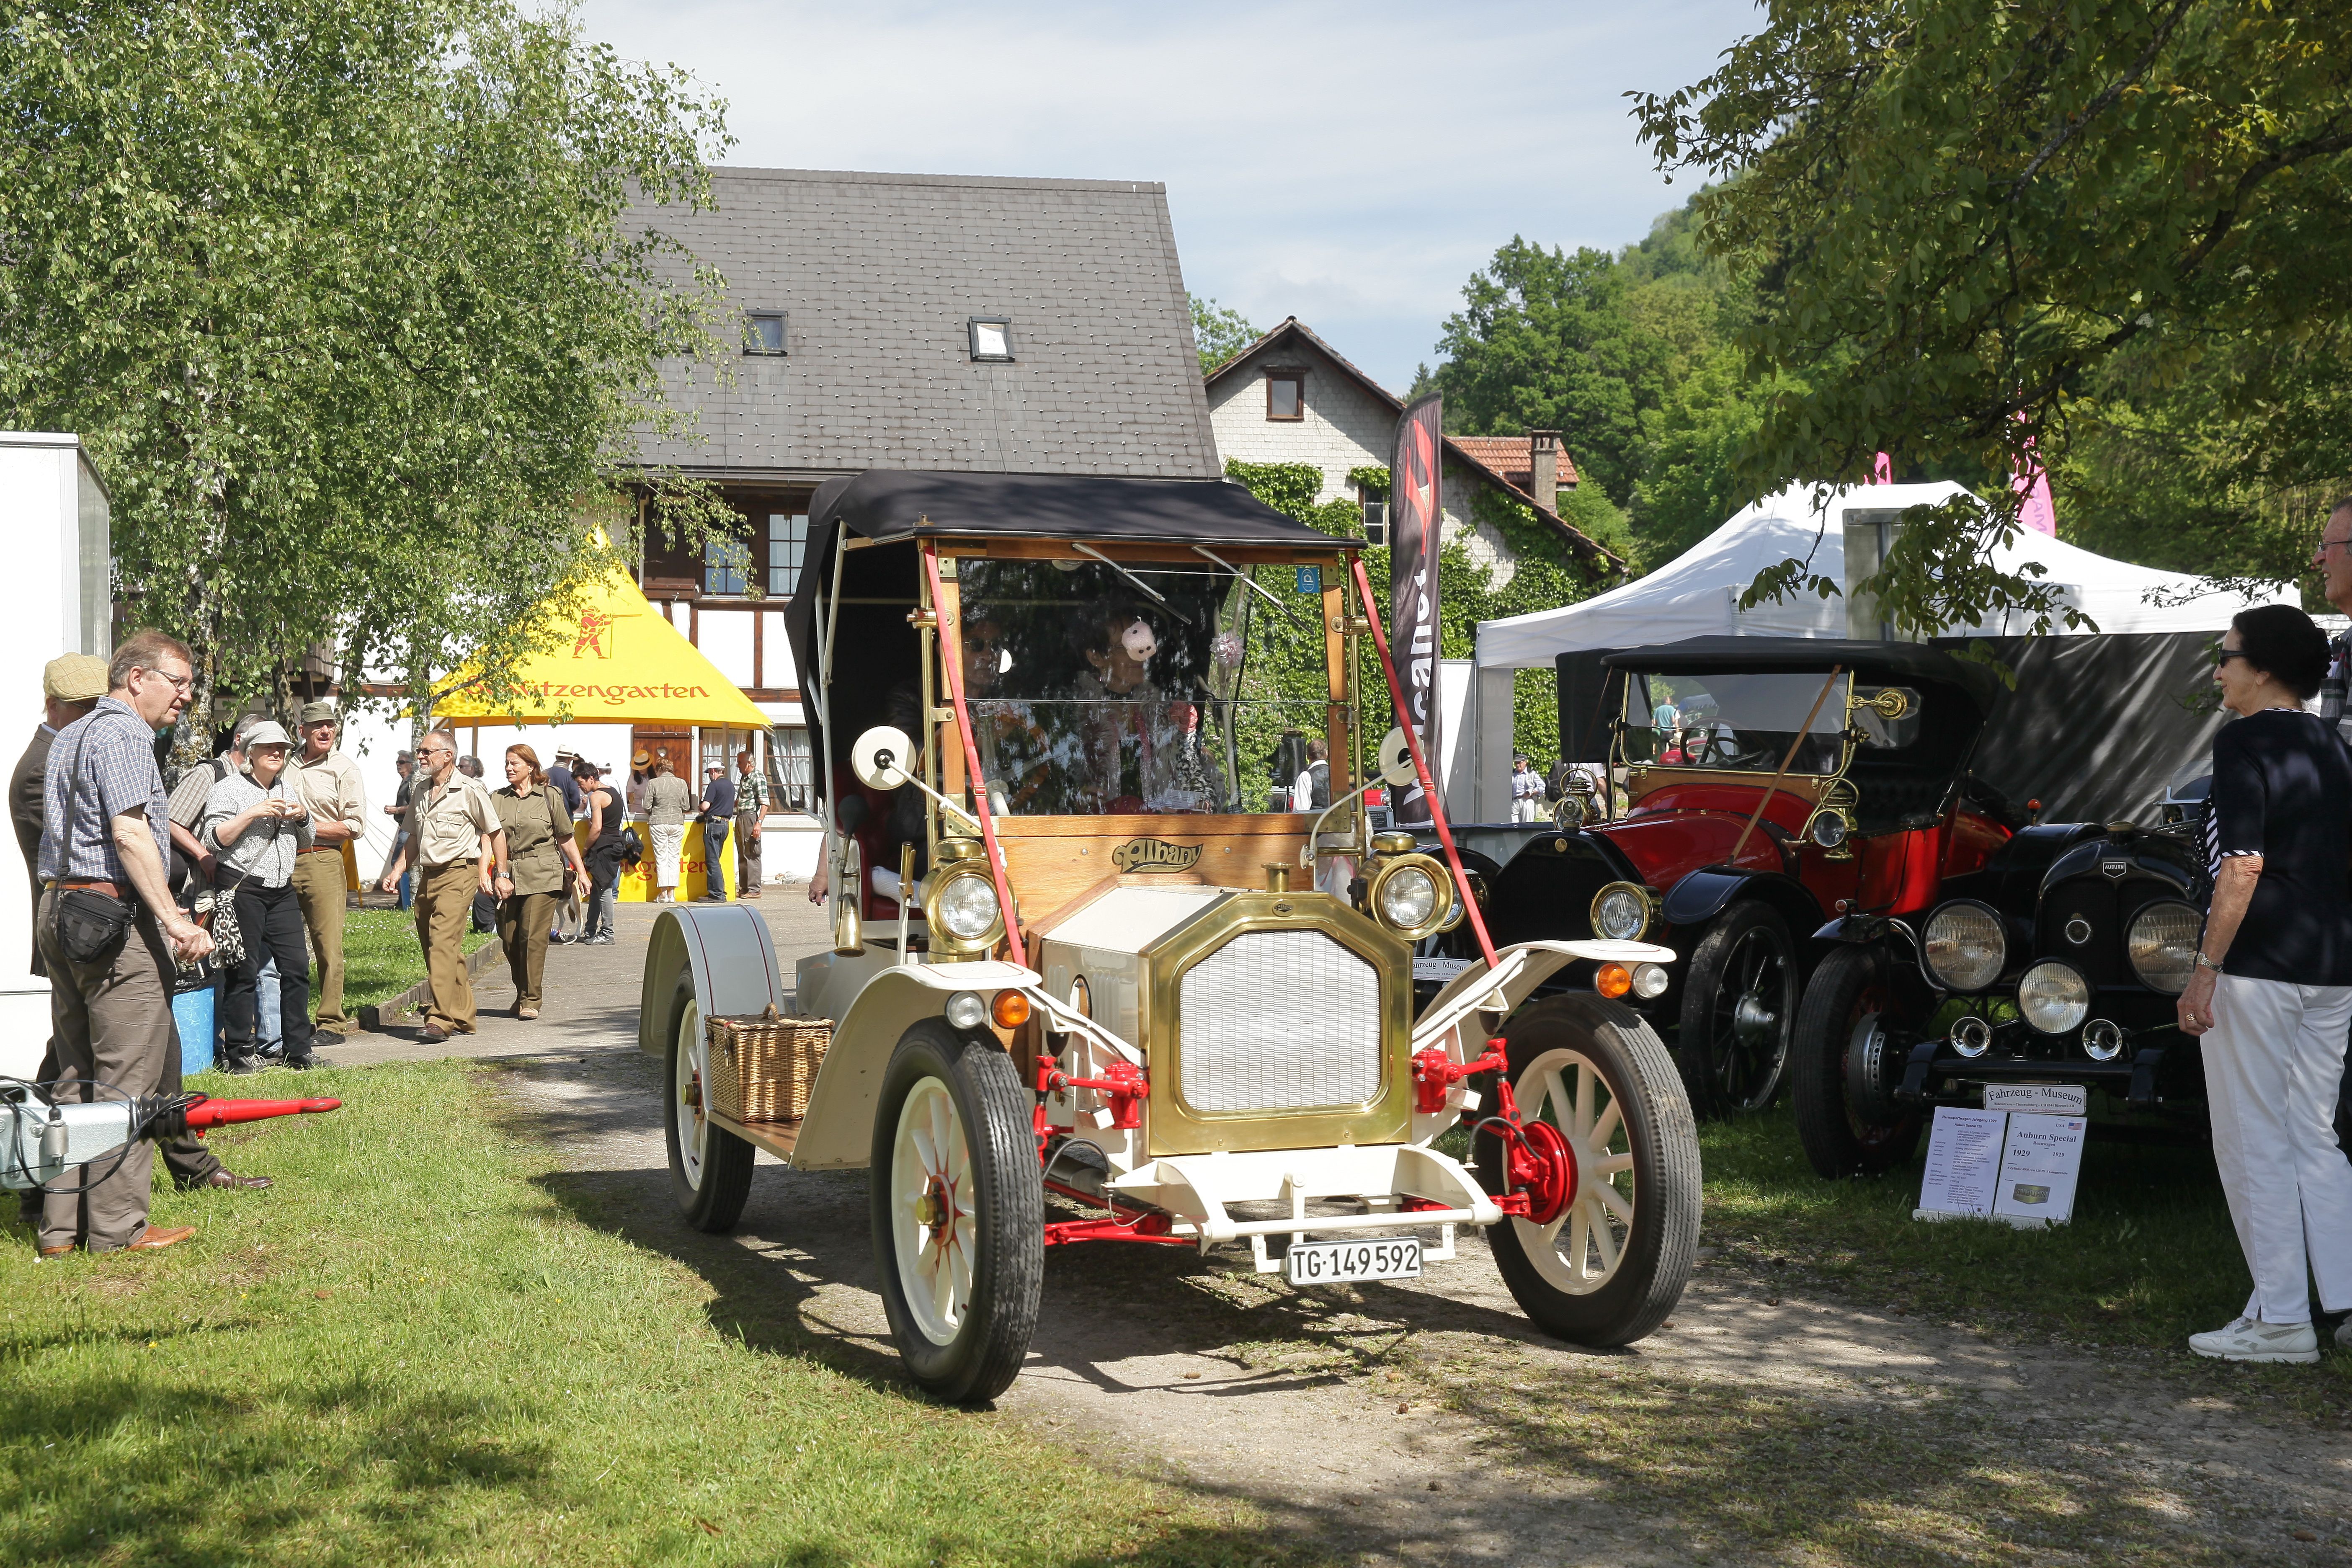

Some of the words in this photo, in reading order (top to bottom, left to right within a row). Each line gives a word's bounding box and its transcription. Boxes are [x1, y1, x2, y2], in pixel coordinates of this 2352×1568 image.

[1112, 838, 1203, 873] Albany
[1443, 962, 1465, 971] Museu
[1988, 1089, 2032, 1101] Fahrzeug
[2041, 1088, 2082, 1104] Museum
[2017, 1131, 2047, 1140] Auburn
[2049, 1134, 2076, 1142] Special
[2017, 1189, 2047, 1197] AUBURN
